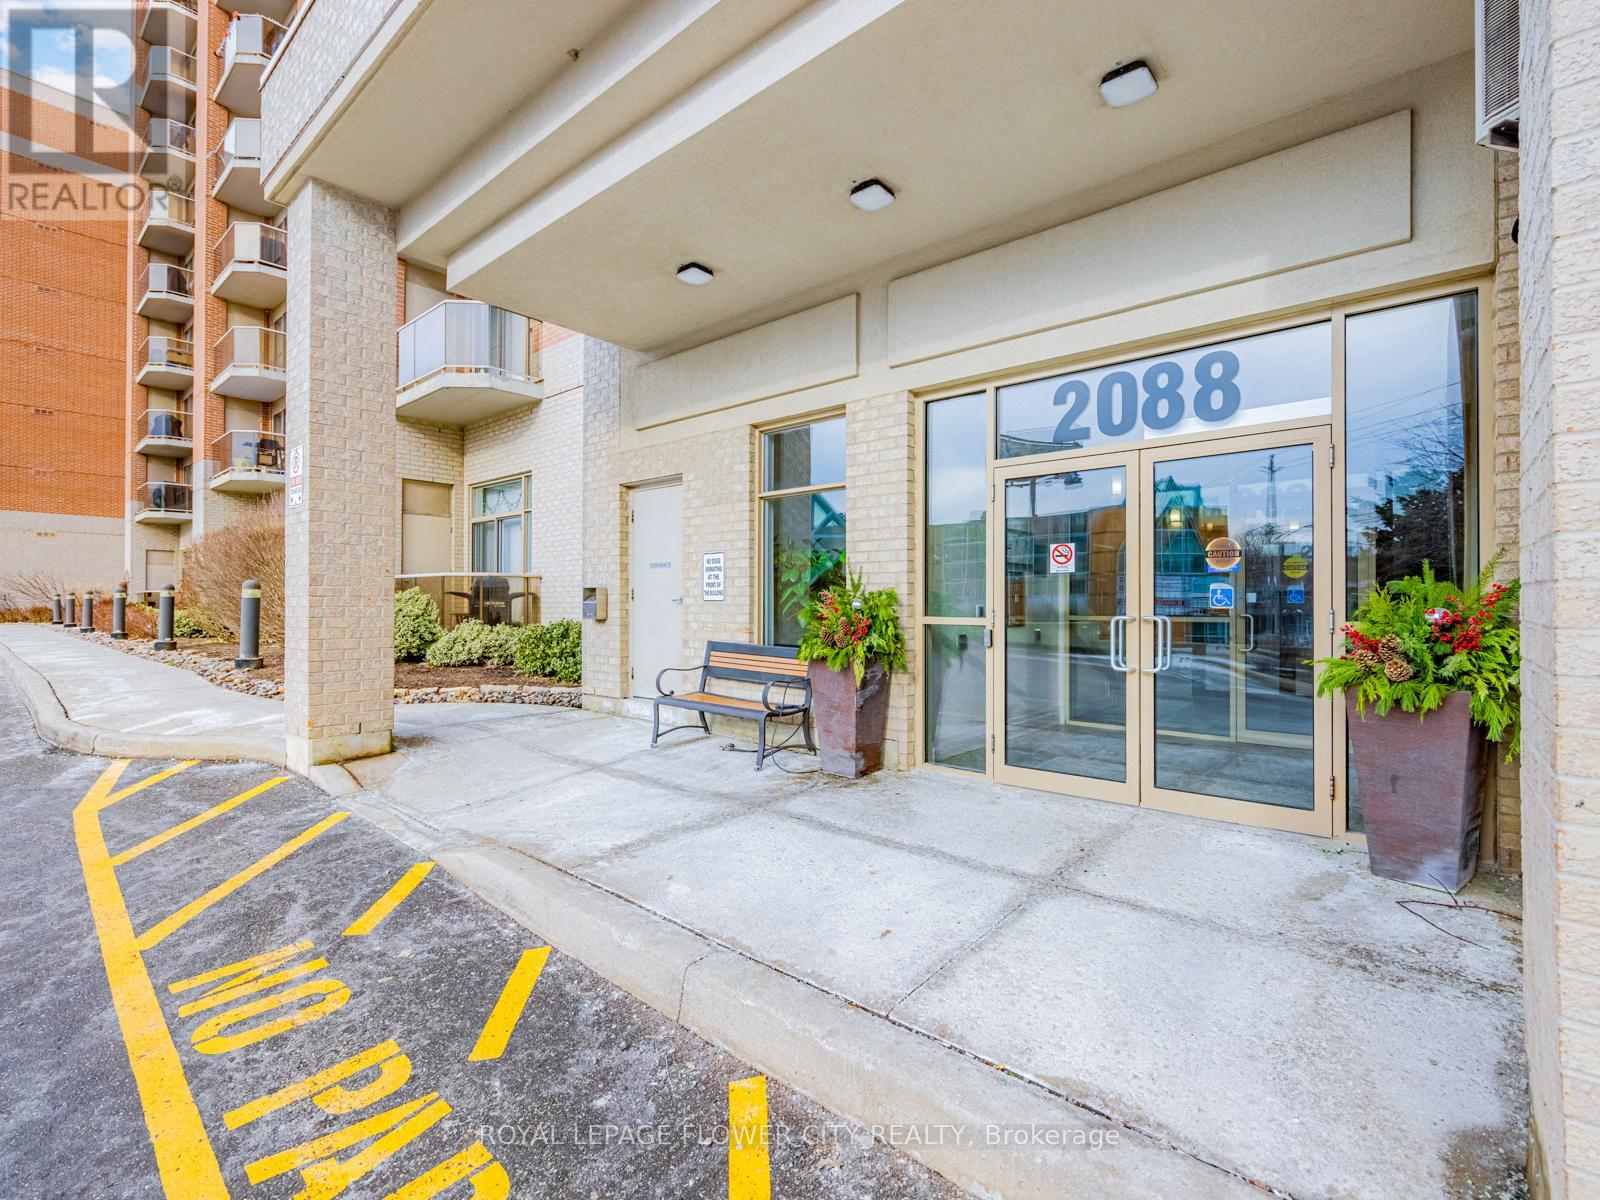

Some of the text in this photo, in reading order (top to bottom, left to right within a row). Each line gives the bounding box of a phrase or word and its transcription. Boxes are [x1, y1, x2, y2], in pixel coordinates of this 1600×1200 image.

[1053, 350, 1241, 443] 2088
[1207, 550, 1240, 558] CAUTION
[168, 940, 351, 1054] NO
